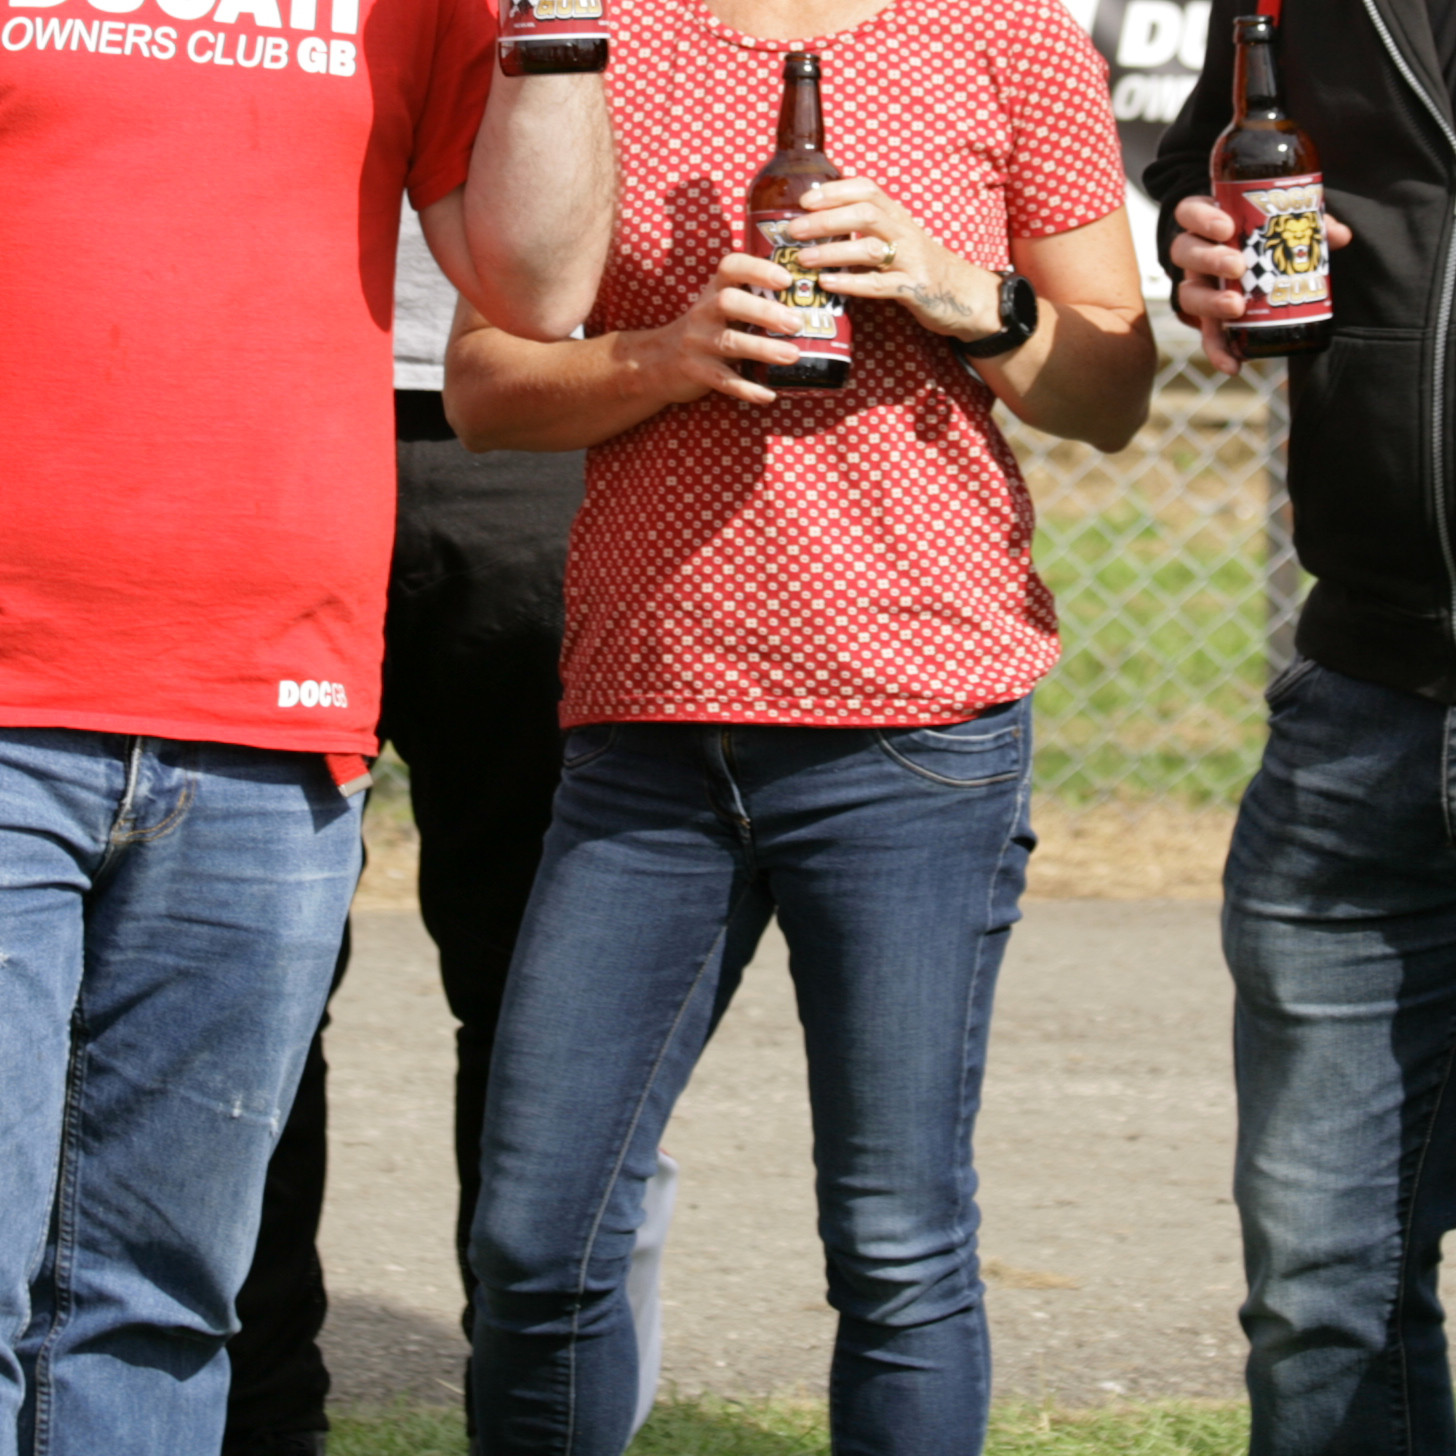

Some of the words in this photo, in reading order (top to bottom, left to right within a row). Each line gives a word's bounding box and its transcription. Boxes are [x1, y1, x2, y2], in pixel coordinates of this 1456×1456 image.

[1, 16, 178, 60] OWNERS
[187, 29, 289, 70] CLUB
[296, 36, 357, 77] GB
